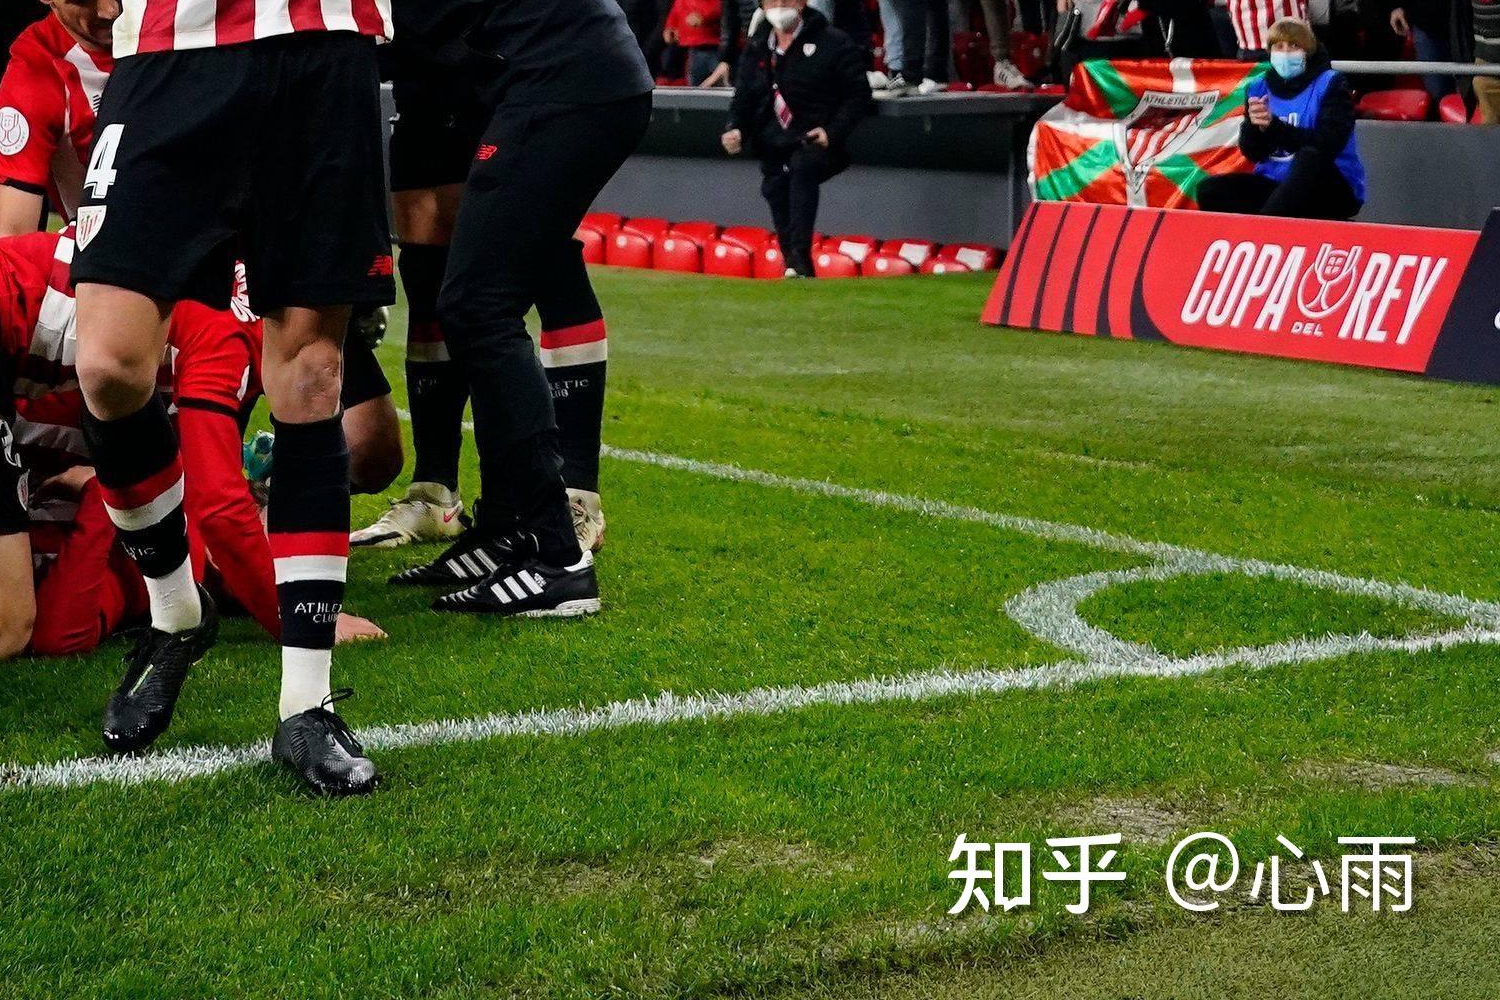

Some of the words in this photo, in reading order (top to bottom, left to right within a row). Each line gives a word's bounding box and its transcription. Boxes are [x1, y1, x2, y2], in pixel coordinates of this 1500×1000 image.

[1142, 93, 1188, 106] ATHLETIC
[1190, 94, 1216, 105] CLUB
[84, 123, 125, 199] 4
[1181, 238, 1307, 333] COPA
[1290, 320, 1324, 338] DEL
[1338, 251, 1449, 346] REY
